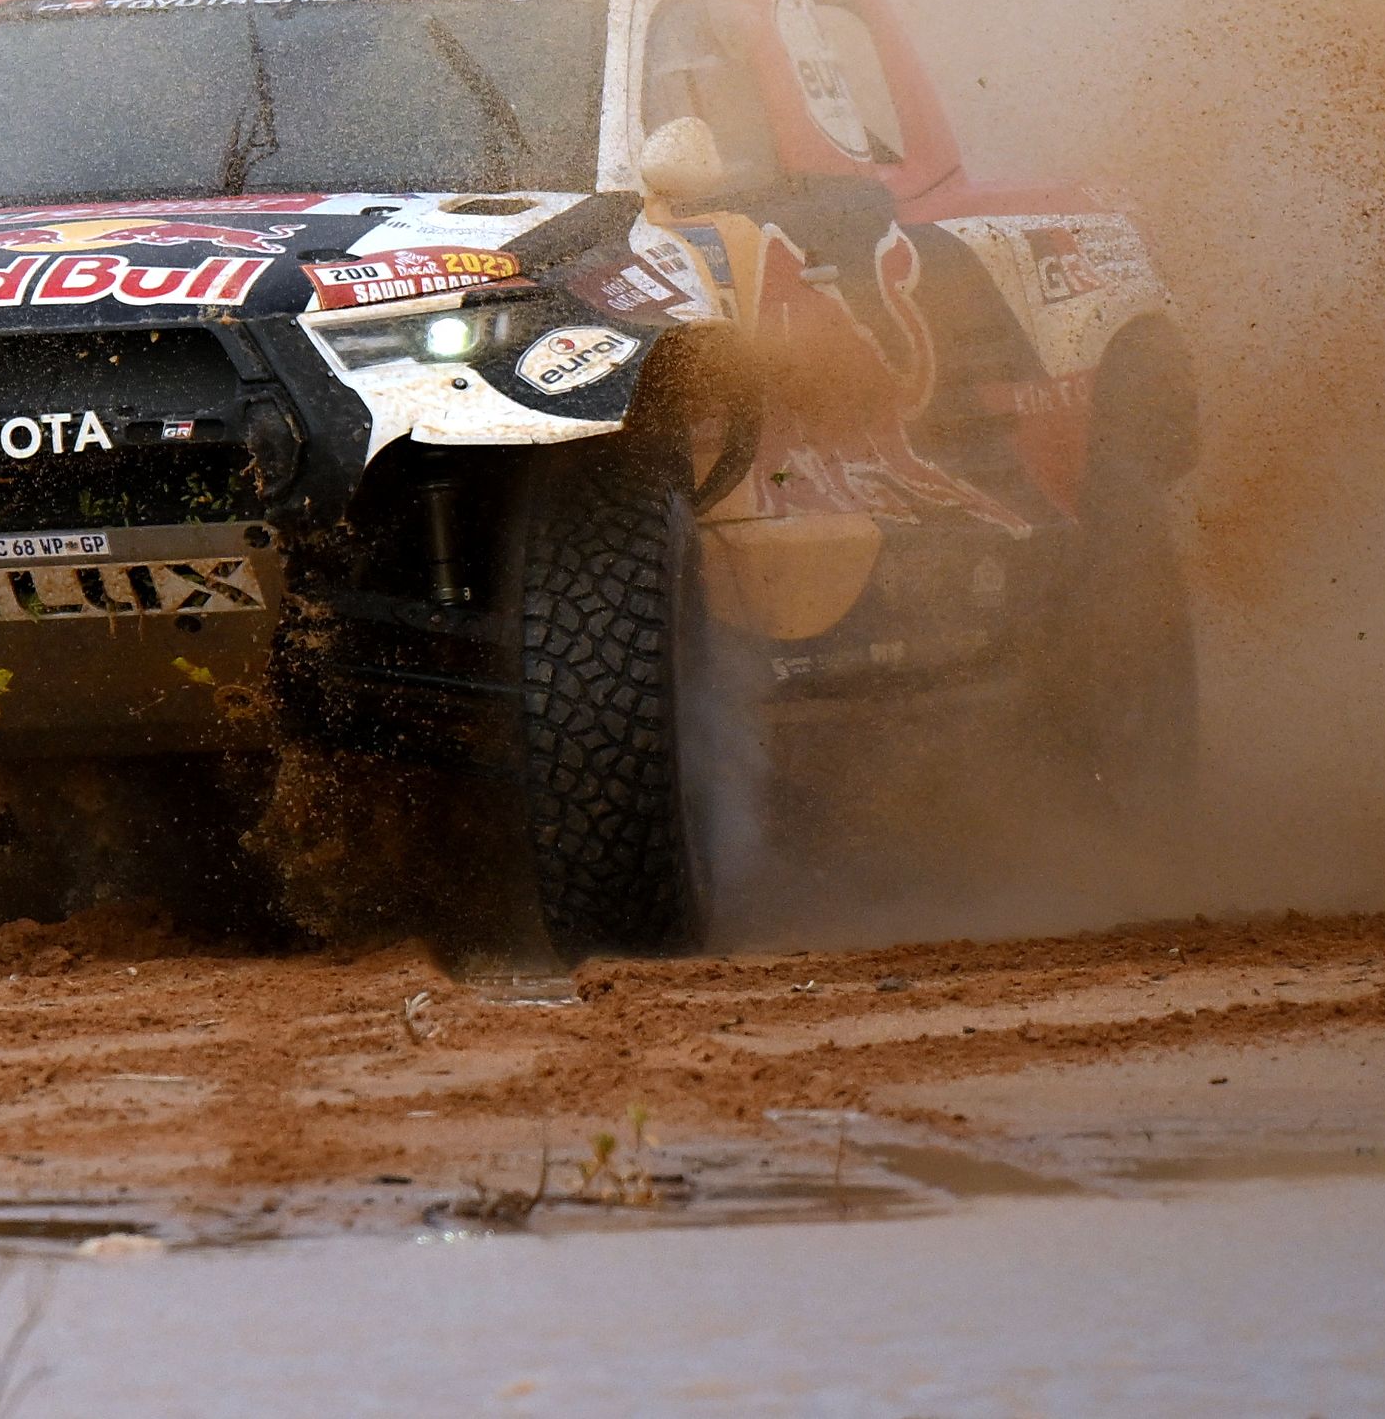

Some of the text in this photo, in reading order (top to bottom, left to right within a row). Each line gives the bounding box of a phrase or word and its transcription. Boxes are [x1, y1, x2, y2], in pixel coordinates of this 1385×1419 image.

[329, 265, 379, 282] 200
[395, 261, 443, 277] DAKAR
[442, 253, 514, 277] 2023
[34, 255, 272, 306] Bull
[352, 279, 416, 304] SAUDI
[539, 334, 625, 385] eurol
[13, 539, 35, 556] 68
[39, 537, 64, 555] WP
[80, 535, 105, 553] GP
